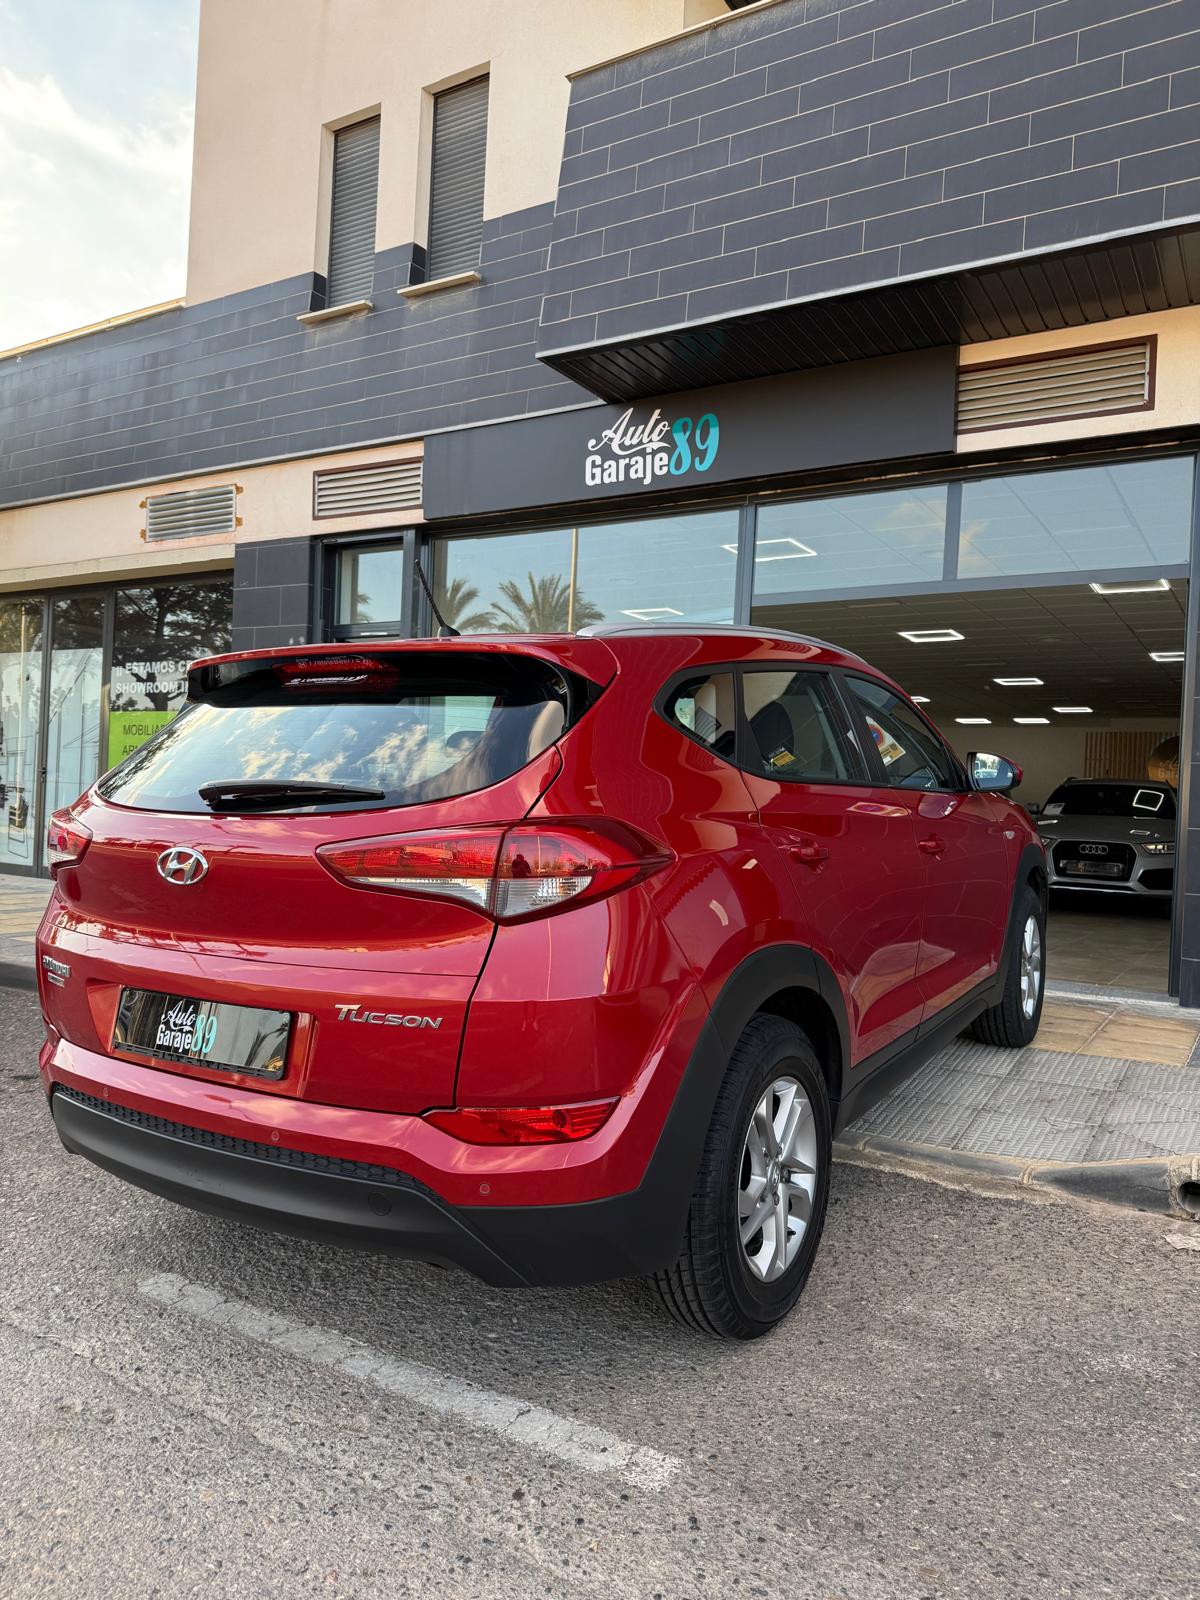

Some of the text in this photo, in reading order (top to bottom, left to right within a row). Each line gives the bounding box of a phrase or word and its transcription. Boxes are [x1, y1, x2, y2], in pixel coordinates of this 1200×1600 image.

[585, 413, 720, 486] Garaje 89
[587, 407, 671, 455] Auto
[115, 681, 178, 693] SHOWROOM
[156, 1014, 218, 1053] Garaje 89
[161, 1000, 196, 1031] Auto
